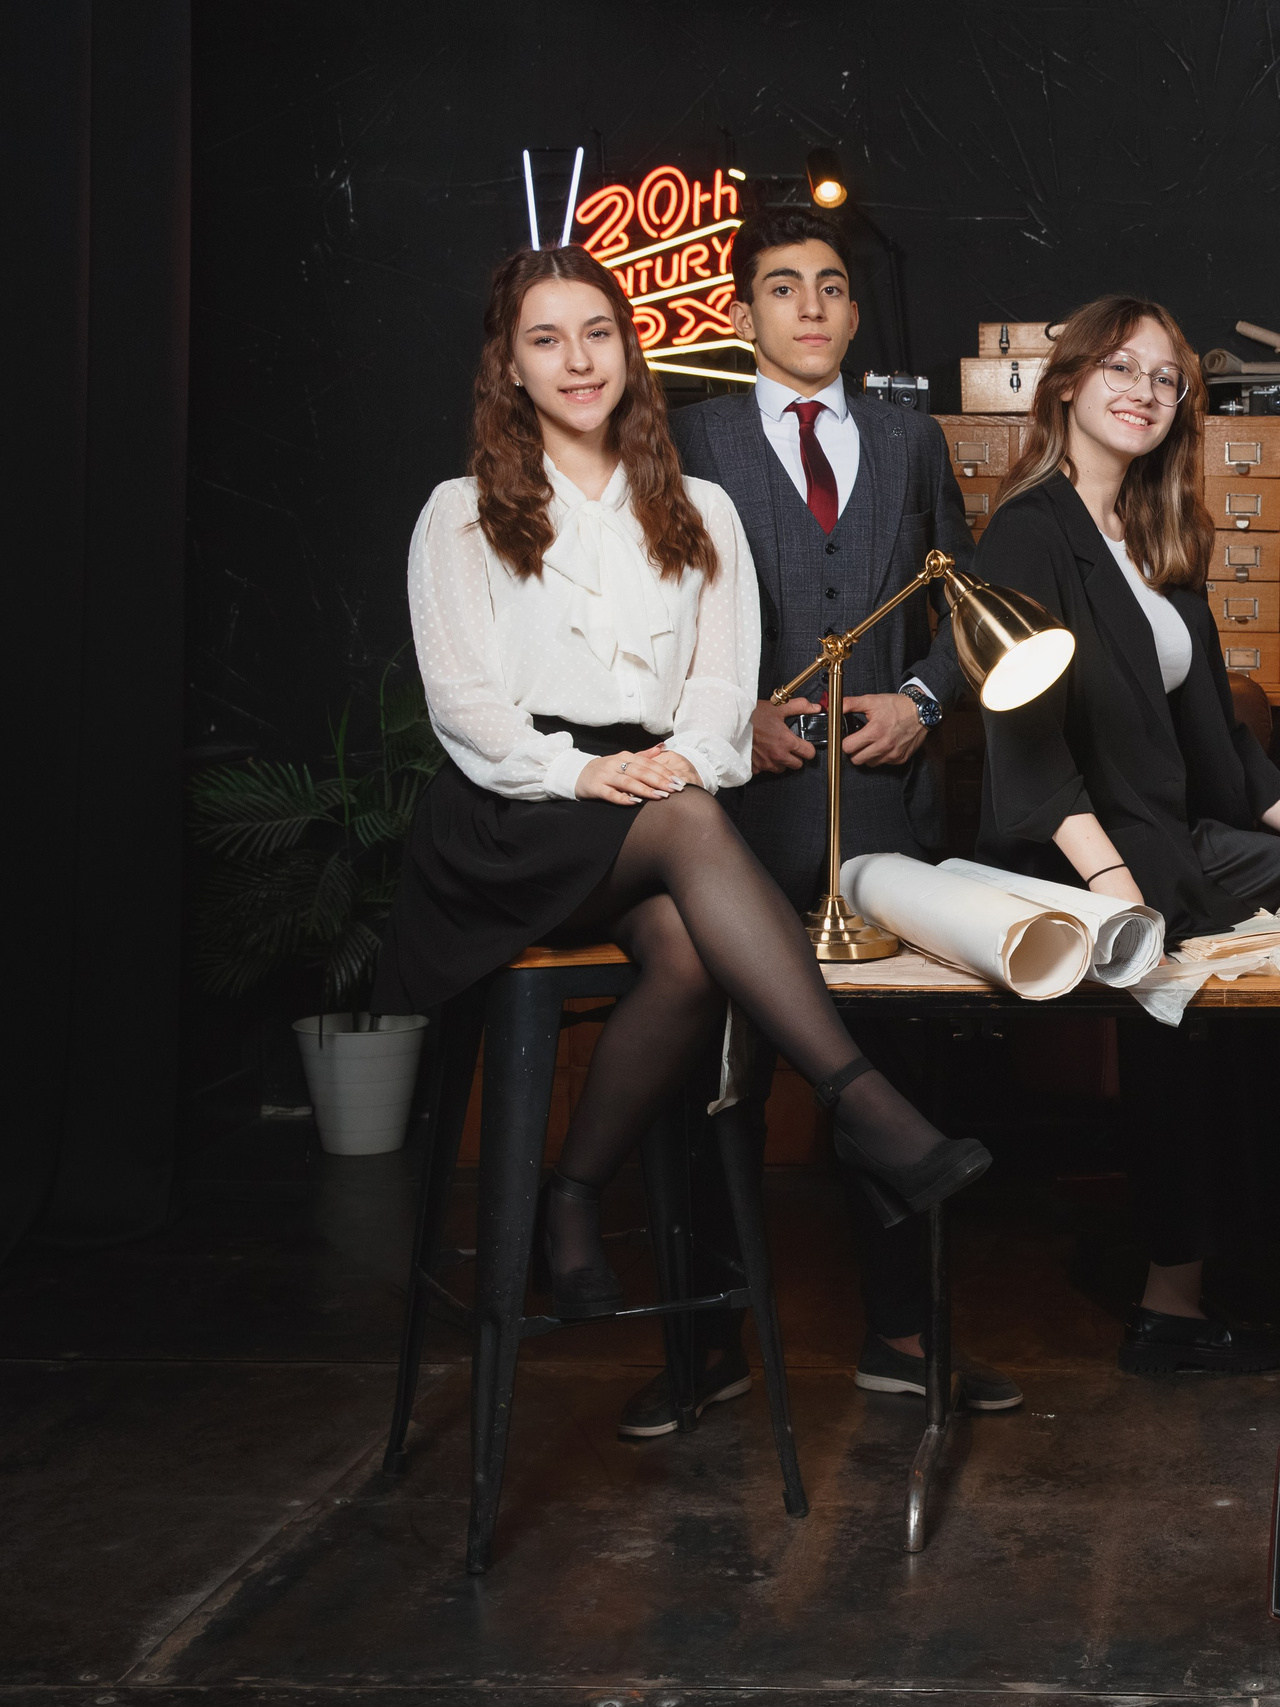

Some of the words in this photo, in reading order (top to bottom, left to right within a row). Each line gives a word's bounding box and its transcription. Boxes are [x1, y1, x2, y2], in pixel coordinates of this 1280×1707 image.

[576, 166, 738, 260] 20th
[612, 231, 736, 297] NTURY
[632, 283, 736, 350] OX
